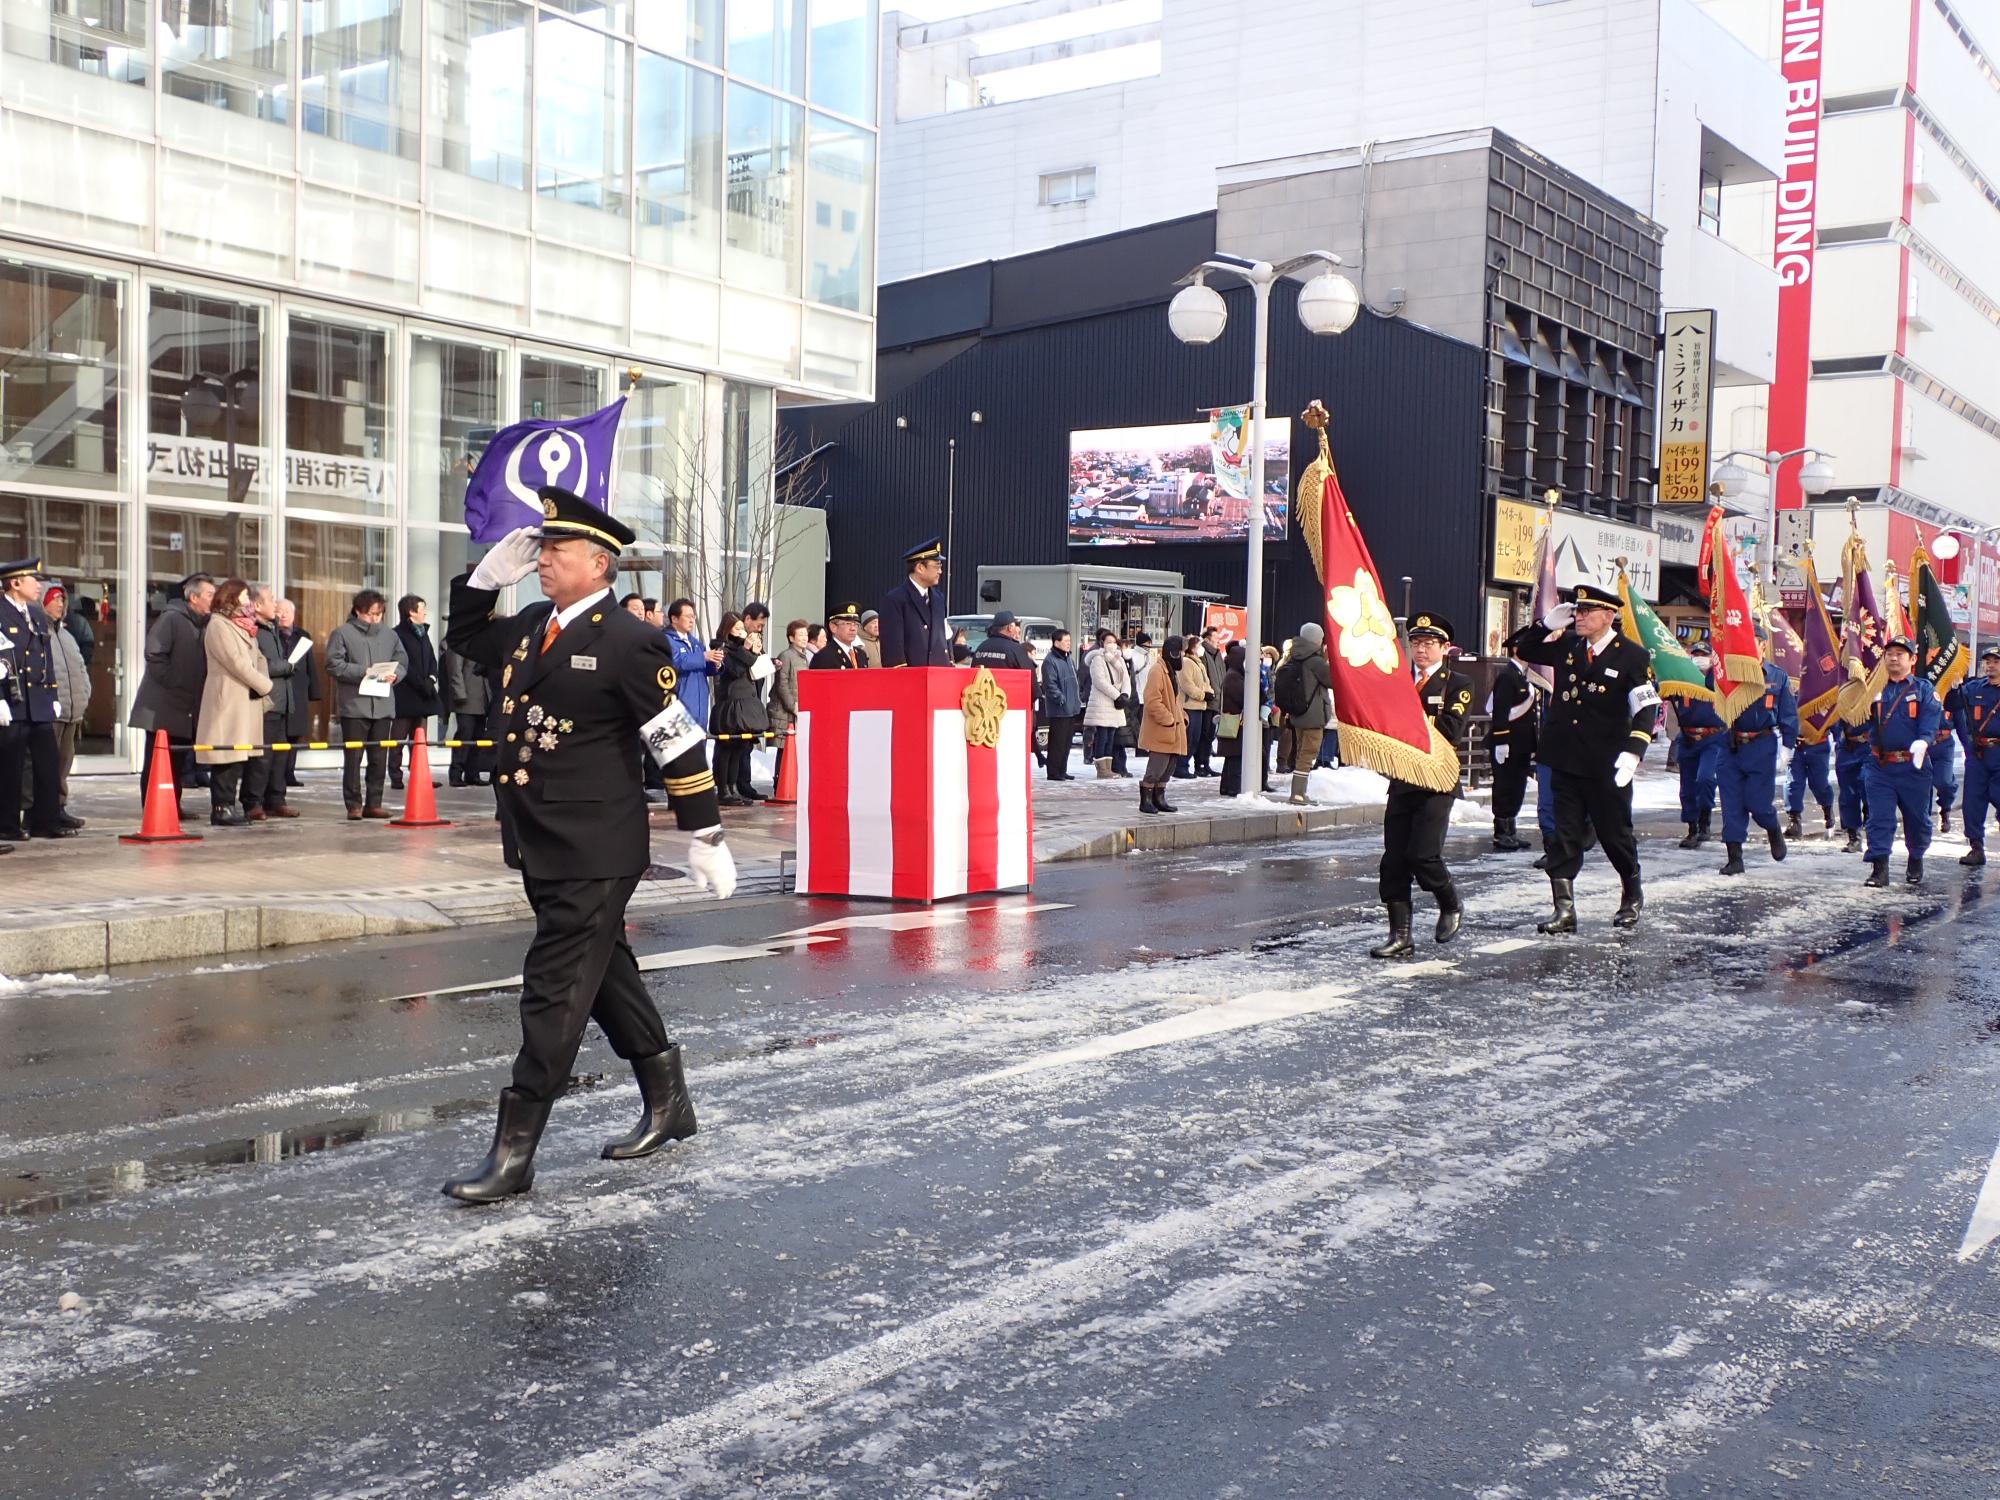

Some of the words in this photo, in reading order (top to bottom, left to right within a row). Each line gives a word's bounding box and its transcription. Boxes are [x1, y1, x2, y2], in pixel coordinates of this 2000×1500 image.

[1776, 79, 1818, 287] BUILDING
[1669, 342, 1688, 432] ミライザカ
[1666, 446, 1700, 457] ハイボール
[1666, 474, 1698, 486] 生ビール
[1498, 506, 1523, 522] ハイボール
[1497, 541, 1523, 557] 生ビール
[1596, 554, 1652, 592] ミラザカ
